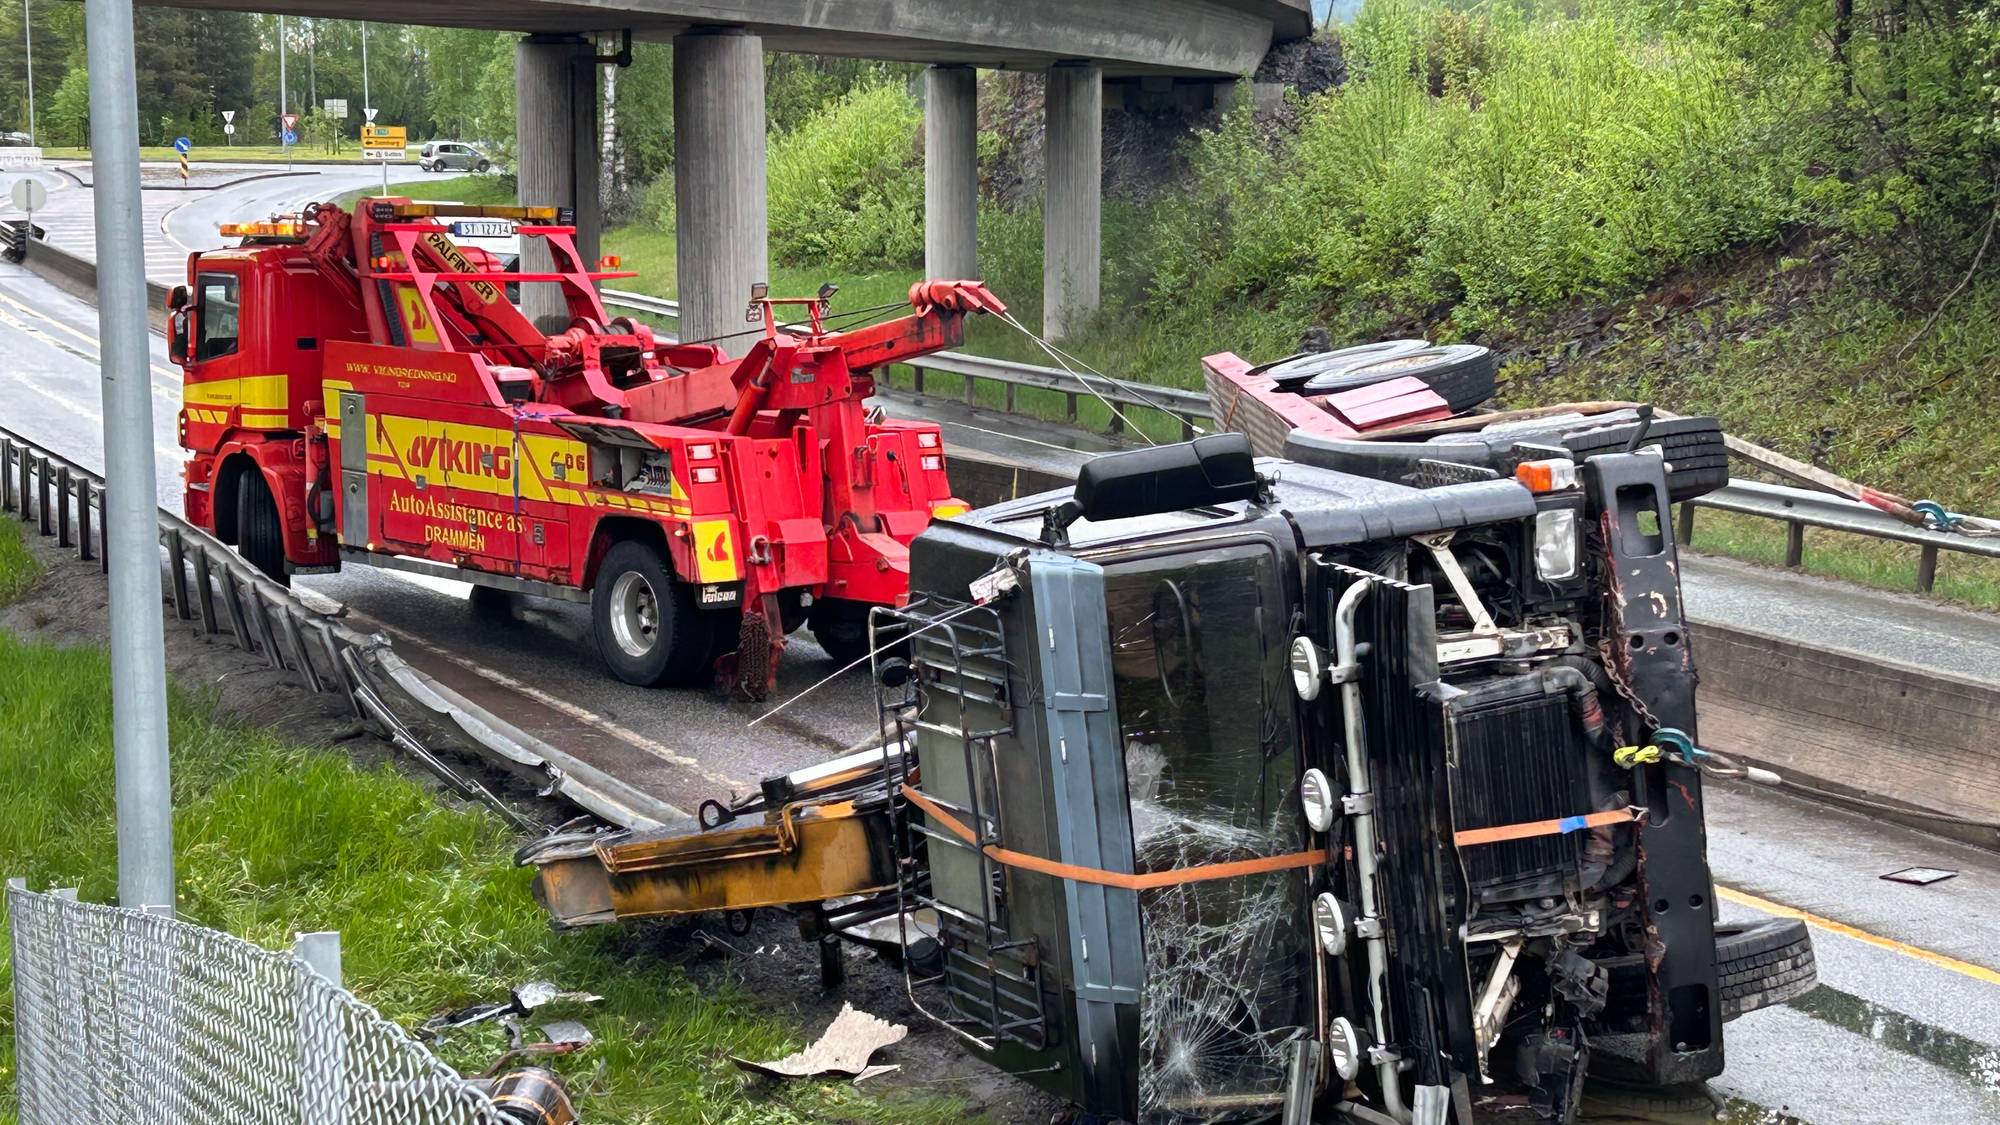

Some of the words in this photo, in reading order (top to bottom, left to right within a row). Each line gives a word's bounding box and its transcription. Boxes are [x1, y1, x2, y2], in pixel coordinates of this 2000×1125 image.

[464, 223, 475, 235] ST
[427, 233, 495, 300] PALFINER
[389, 488, 502, 529] AutoAssistance
[424, 524, 485, 551] DRAMMEN
